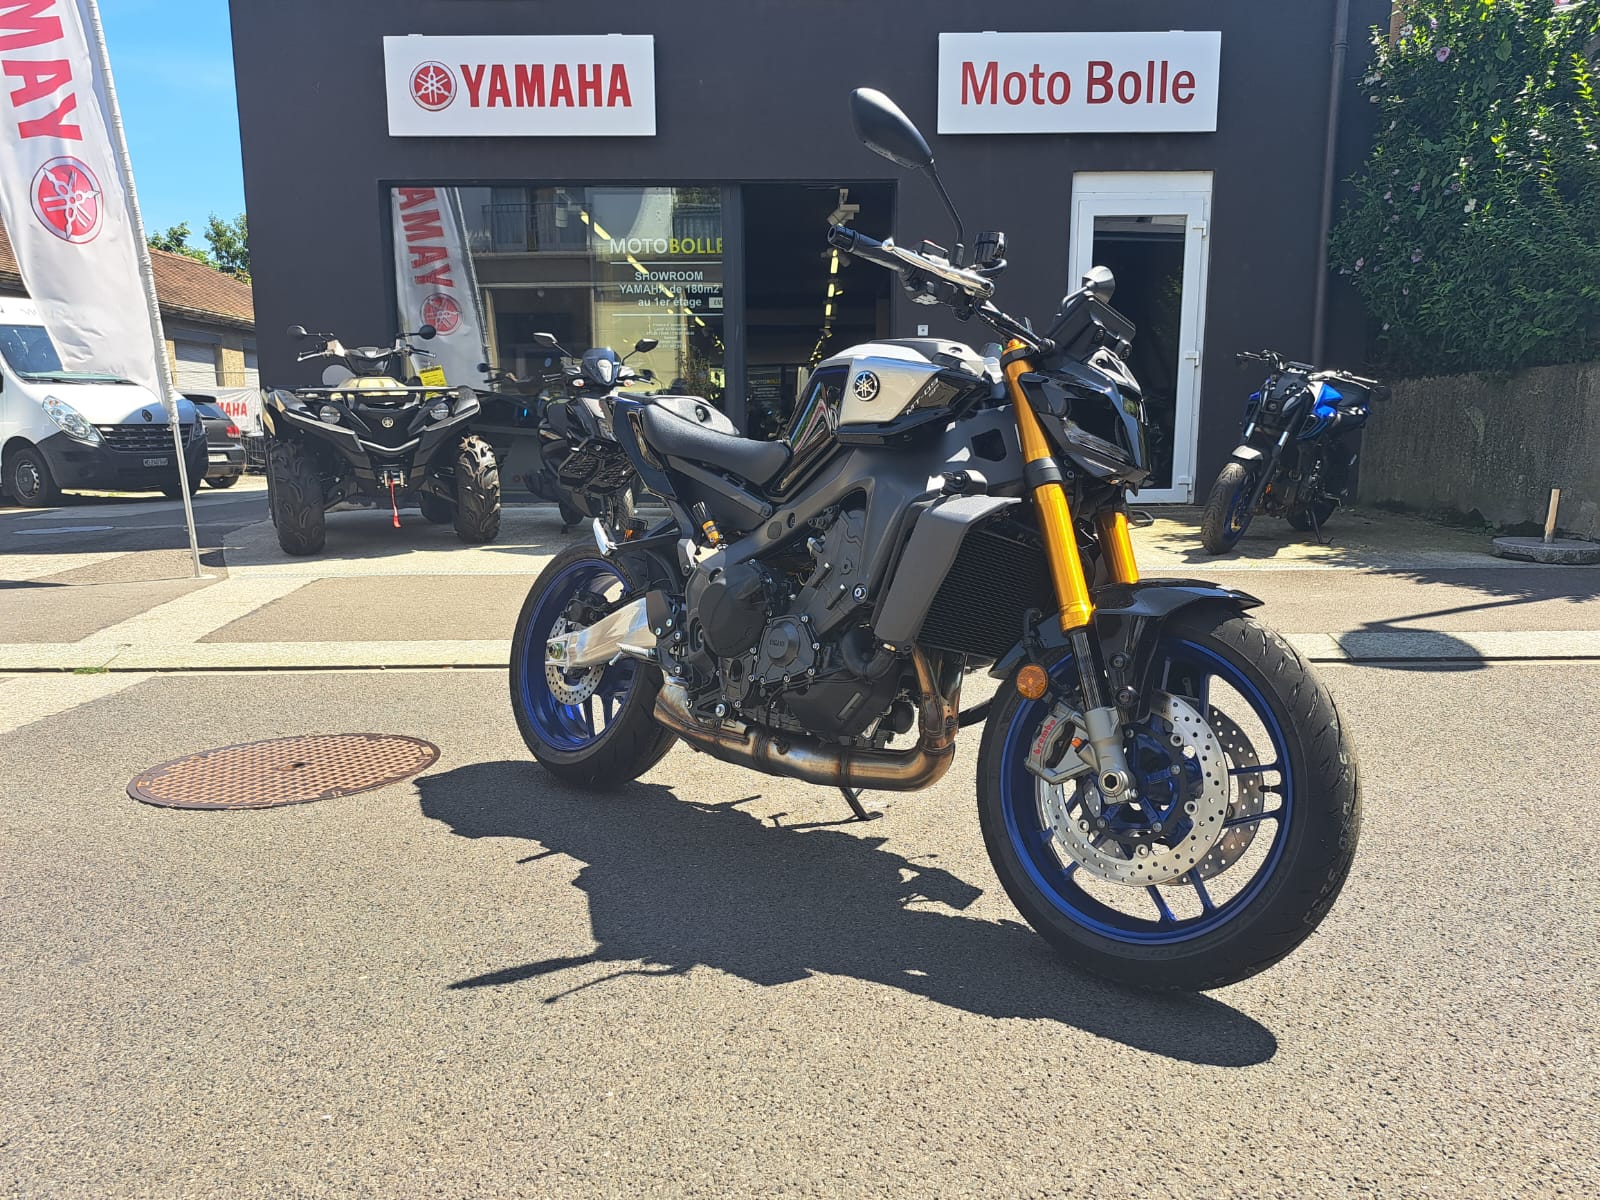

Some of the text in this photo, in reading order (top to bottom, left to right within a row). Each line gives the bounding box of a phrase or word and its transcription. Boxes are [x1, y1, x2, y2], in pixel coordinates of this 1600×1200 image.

[459, 63, 633, 108] YAMAHA
[961, 60, 1196, 105] Moto Bolle
[634, 271, 703, 281] SHOWROOM
[619, 284, 720, 294] YAMAHA de 180m2
[638, 299, 651, 307] au
[654, 298, 671, 307] 1er
[673, 298, 702, 309] étage
[1033, 719, 1057, 755] brembo
